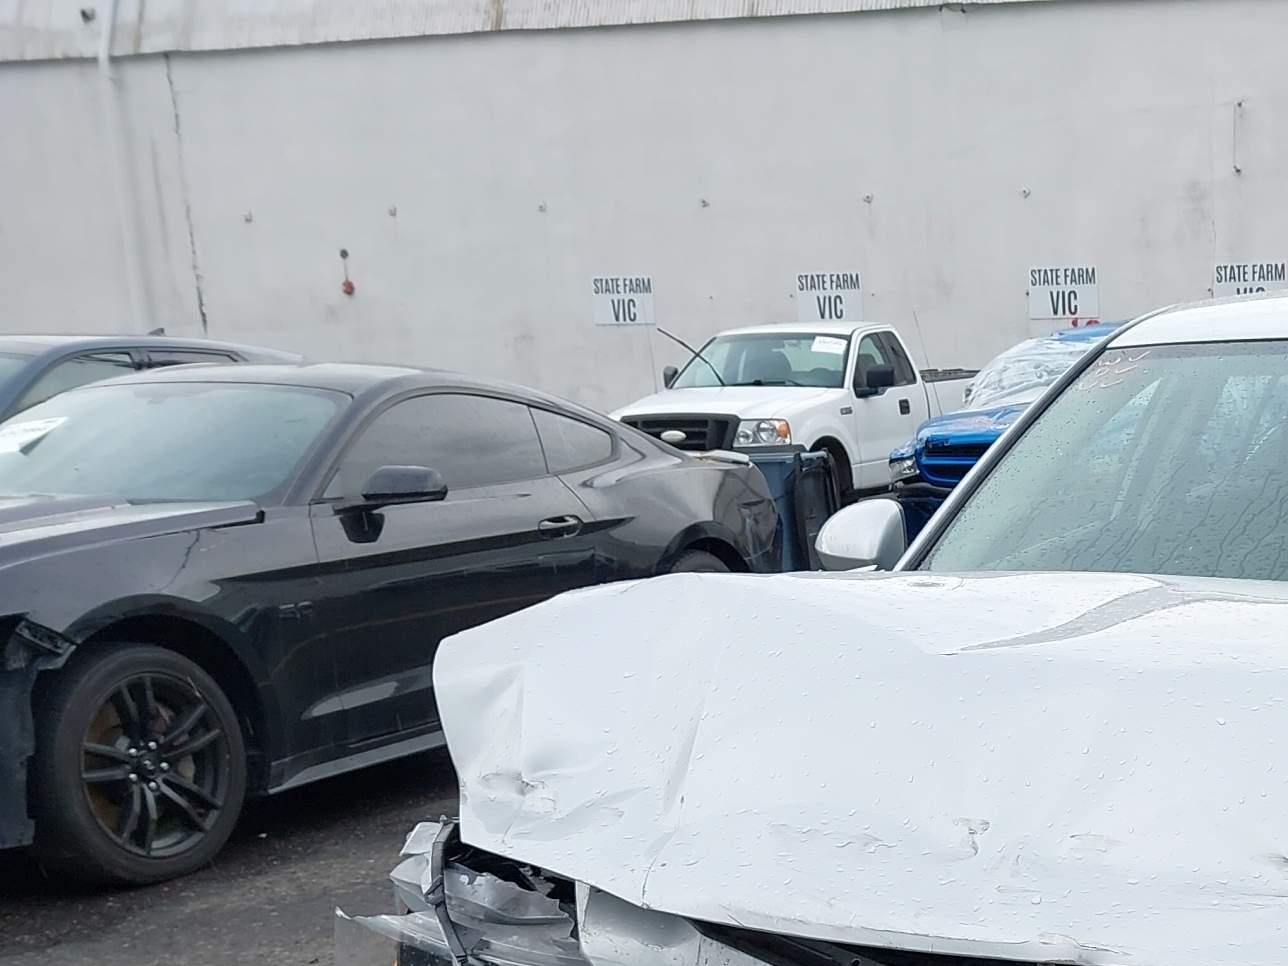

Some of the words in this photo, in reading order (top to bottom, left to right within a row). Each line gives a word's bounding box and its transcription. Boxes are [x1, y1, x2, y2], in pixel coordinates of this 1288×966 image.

[797, 274, 827, 292] STATE
[829, 273, 860, 290] FARM
[1030, 268, 1061, 287] STATE
[1063, 267, 1096, 286] FARM
[1215, 264, 1249, 284] STATE
[1252, 263, 1286, 282] FARM
[593, 278, 621, 295] STATE
[623, 277, 652, 294] FARM
[611, 298, 637, 322] VIC
[816, 294, 844, 320] VIC
[1049, 290, 1079, 316] VIC
